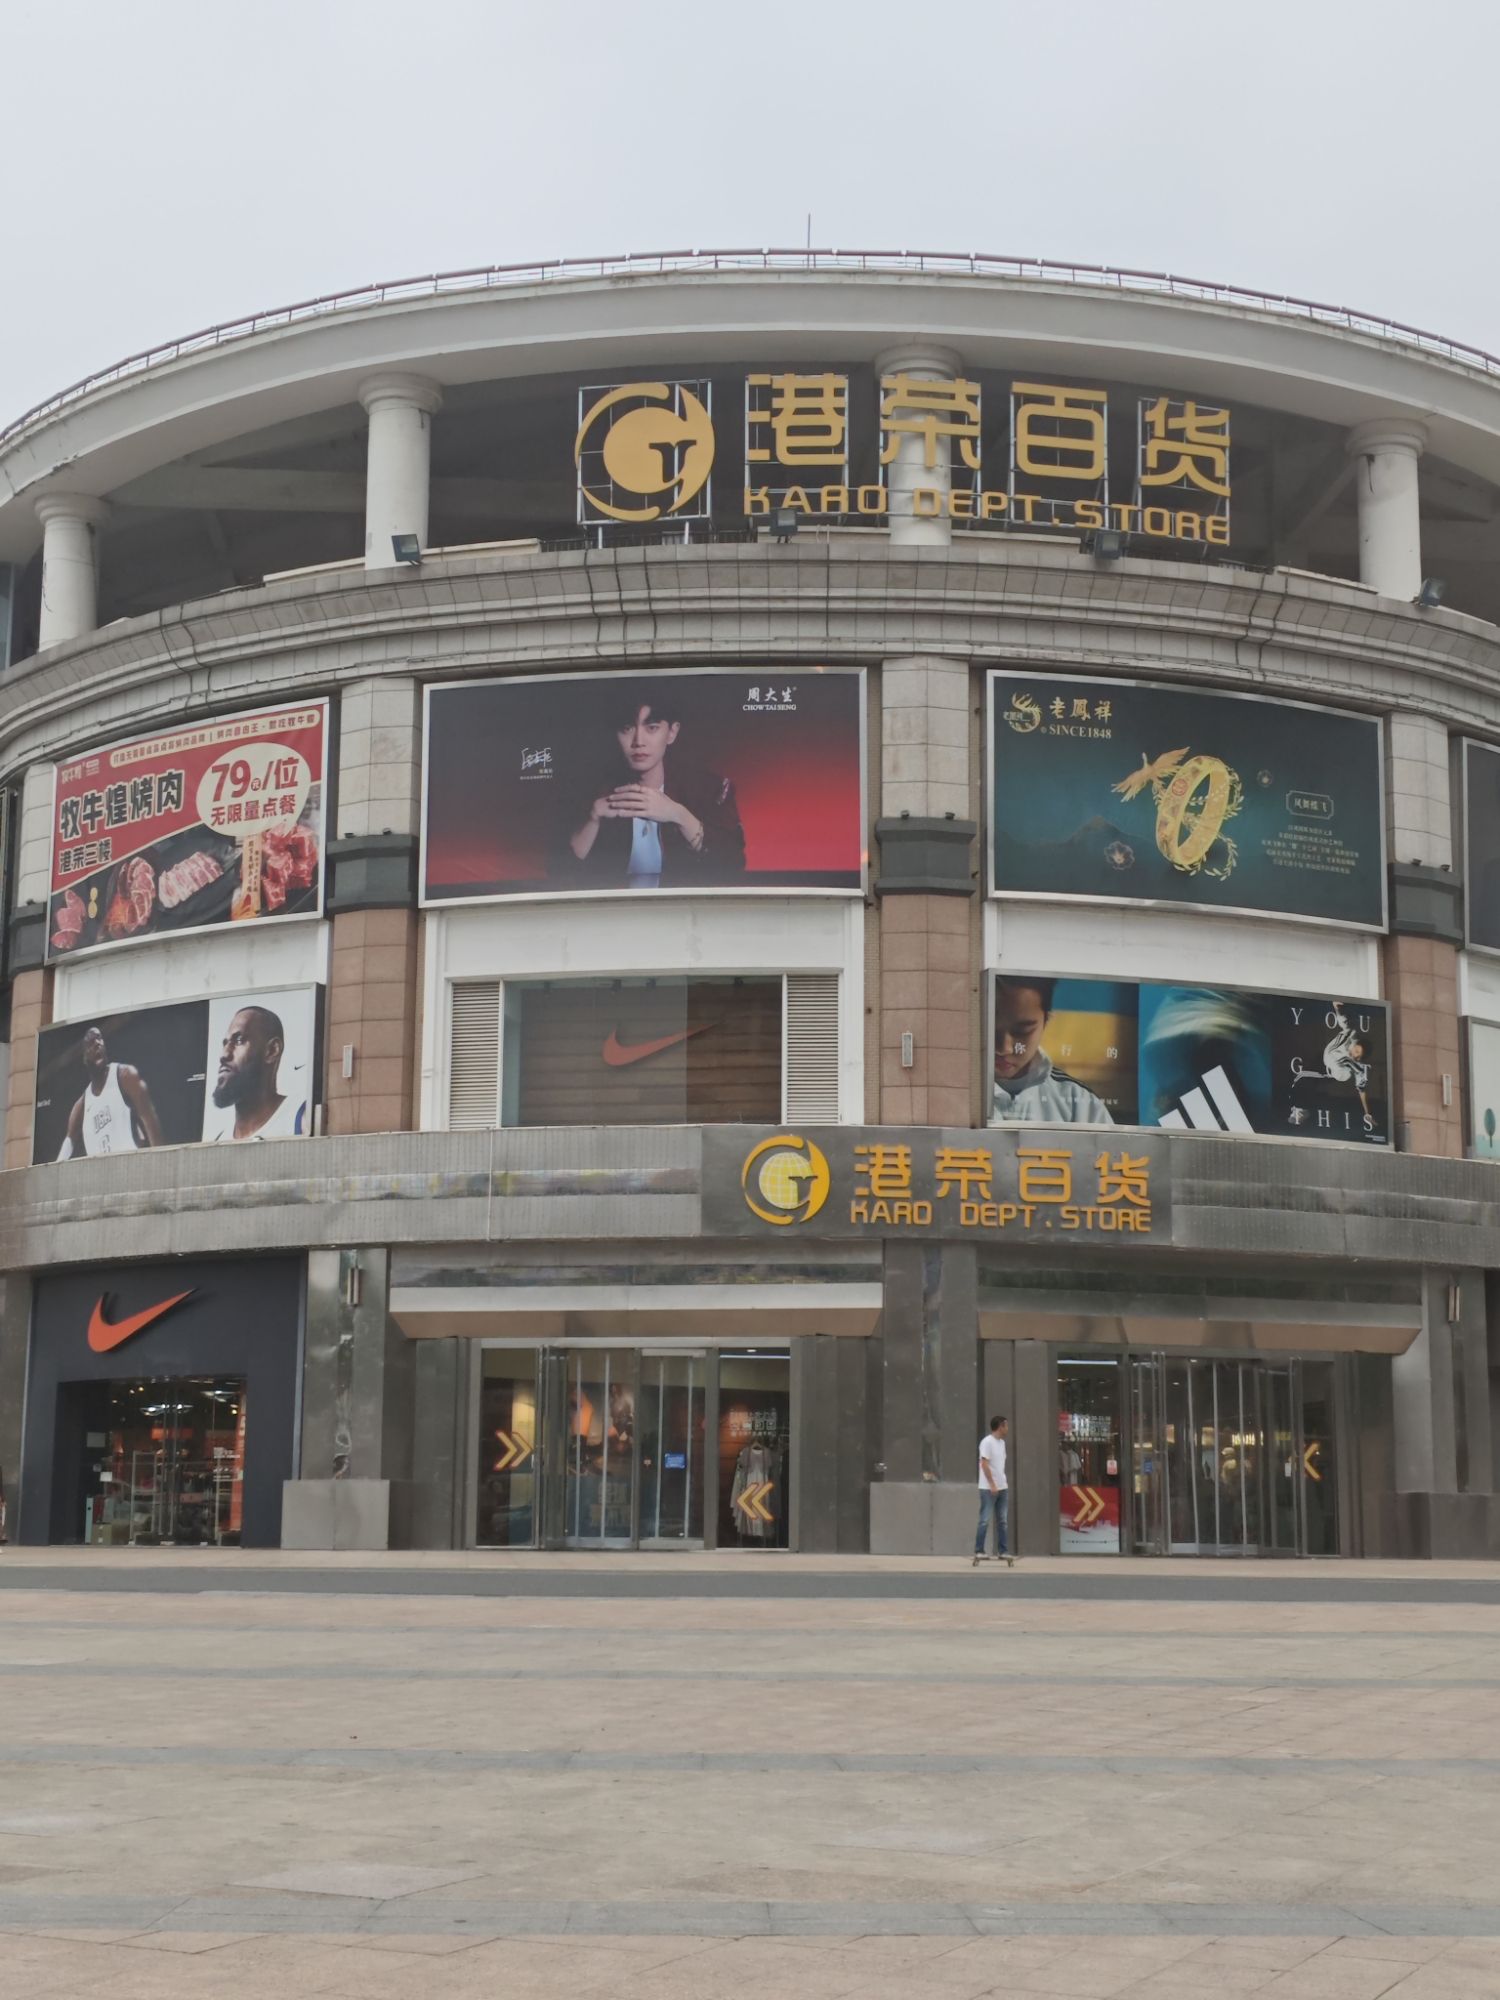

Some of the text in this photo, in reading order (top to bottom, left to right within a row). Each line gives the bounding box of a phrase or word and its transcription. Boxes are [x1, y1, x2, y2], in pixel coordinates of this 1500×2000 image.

[745, 373, 1231, 497] 港荣百货
[744, 485, 886, 515] KARO
[747, 686, 792, 702] 周大生
[60, 769, 184, 841] 牧牛煌烤肉
[211, 794, 296, 826] 无限量点餐
[59, 837, 112, 875] 港荣三楼
[1290, 1007, 1371, 1032] YOU
[1290, 1057, 1371, 1082] GT
[853, 1145, 1151, 1206] 港荣百货
[850, 1200, 932, 1225] KARO
